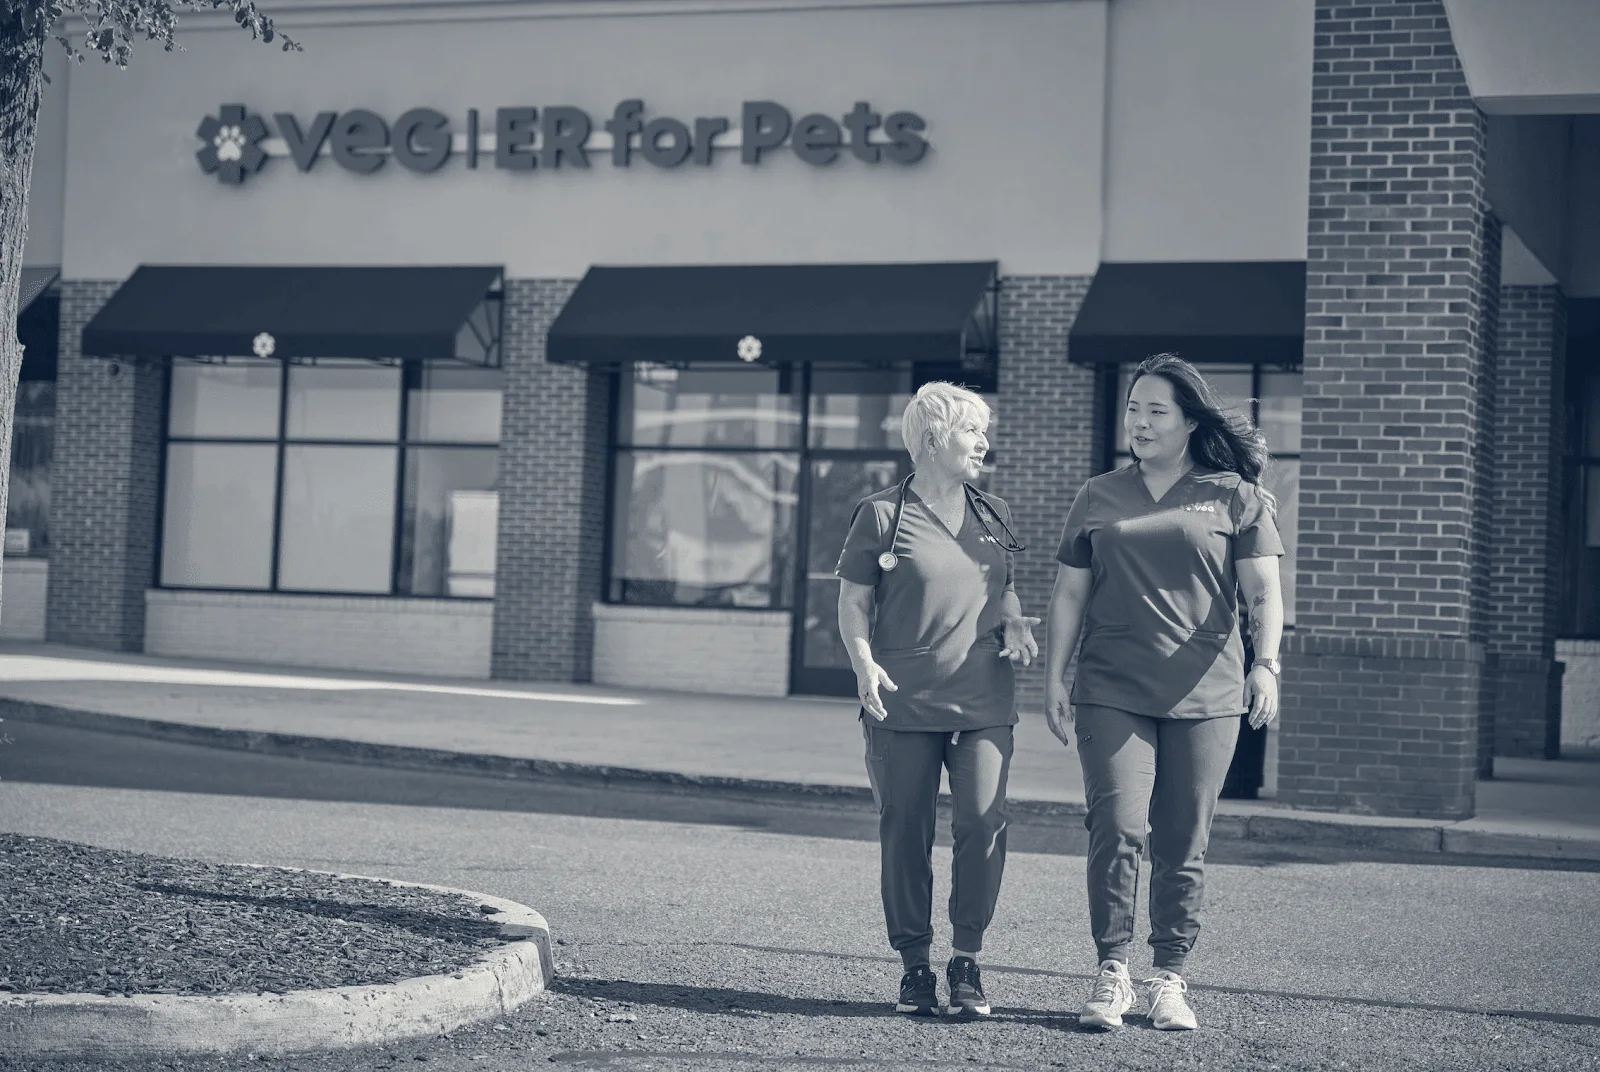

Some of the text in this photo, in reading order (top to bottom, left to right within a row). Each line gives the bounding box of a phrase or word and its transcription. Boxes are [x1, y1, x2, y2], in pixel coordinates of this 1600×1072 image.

[495, 105, 592, 171] ER
[604, 98, 730, 169] for
[741, 100, 930, 167] Pets
